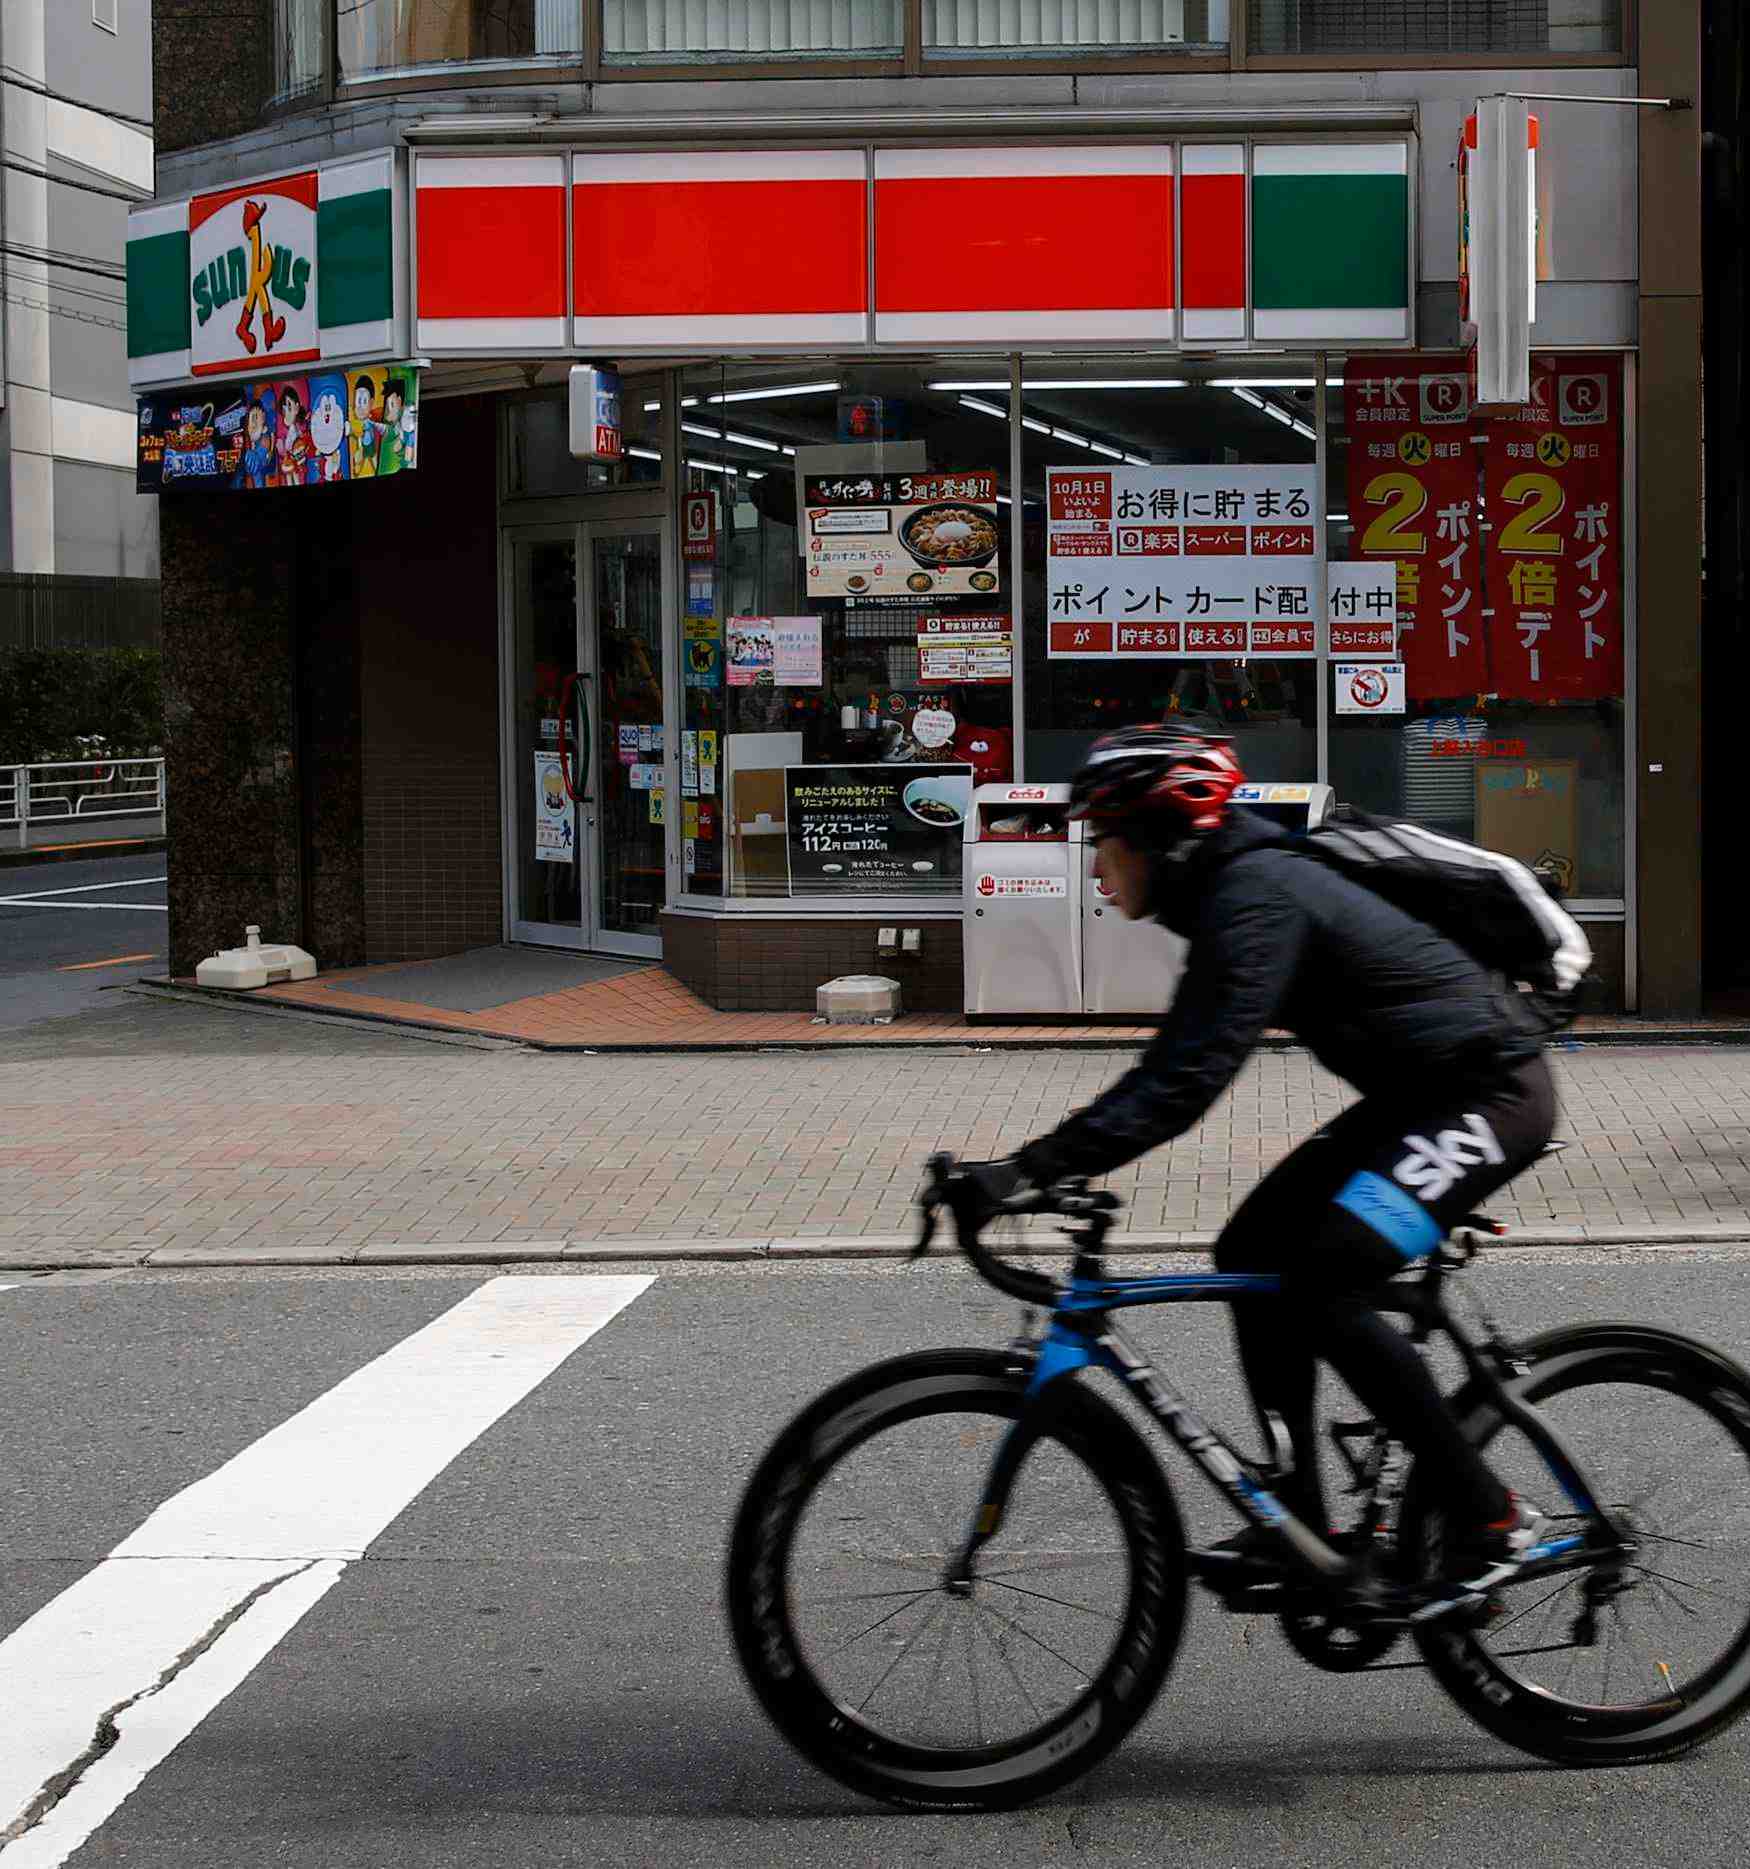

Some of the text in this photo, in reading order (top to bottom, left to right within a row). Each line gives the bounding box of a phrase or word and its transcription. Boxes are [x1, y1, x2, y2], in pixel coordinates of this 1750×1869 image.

[1054, 480, 1105, 495] 10月1日
[1116, 488, 1311, 520] お得に貯まる
[1143, 532, 1178, 550] 楽天
[1185, 532, 1245, 547] スーパー
[1252, 531, 1312, 549] ポイント
[1435, 500, 1472, 658] ポイント
[1574, 502, 1609, 659] ポイント
[1052, 585, 1394, 618] ポイントカード配付中
[1073, 628, 1090, 646] が
[801, 823, 888, 835] アイスコーヒー
[1392, 1112, 1507, 1201] sky
